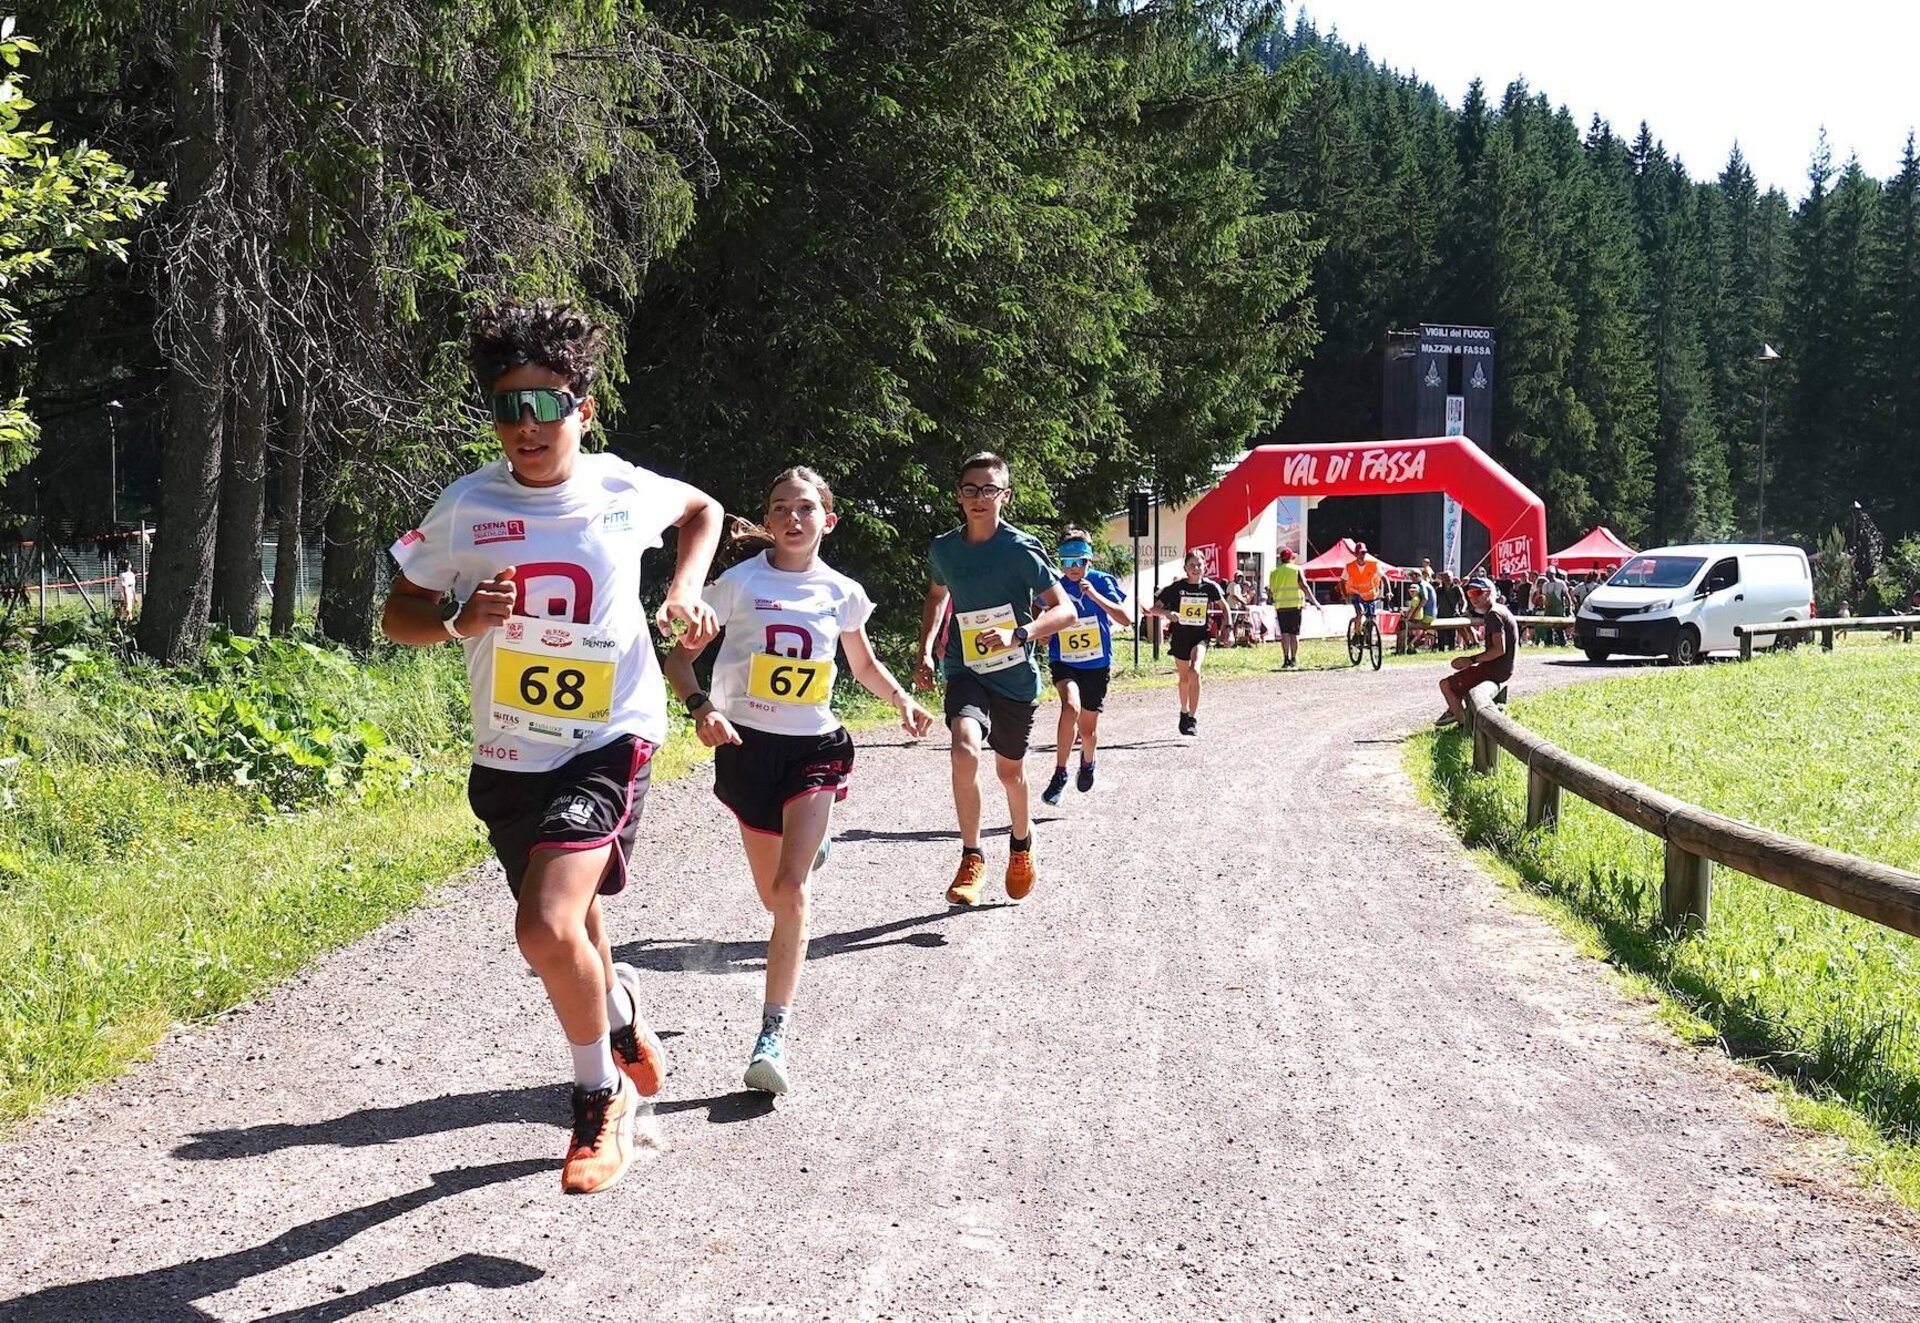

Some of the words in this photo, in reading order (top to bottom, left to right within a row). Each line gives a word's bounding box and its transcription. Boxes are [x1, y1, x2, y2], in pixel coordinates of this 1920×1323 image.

[1425, 328, 1448, 337] VIGILI
[1450, 329, 1461, 337] del
[1463, 329, 1490, 338] FUOCO
[1421, 344, 1452, 353] MAZZIN
[1454, 346, 1461, 354] di
[1463, 346, 1491, 355] FASSA
[1283, 453, 1319, 486] VAL
[1359, 449, 1426, 484] FASSA
[472, 522, 506, 532] CESENA
[1499, 542, 1514, 558] VAL
[1186, 607, 1202, 617] 64
[582, 637, 616, 648] TRENTINO
[1069, 633, 1090, 649] 65
[520, 665, 585, 711] 68
[770, 666, 816, 698] 67
[748, 701, 777, 713] SHOE
[479, 744, 518, 761] SHOE
